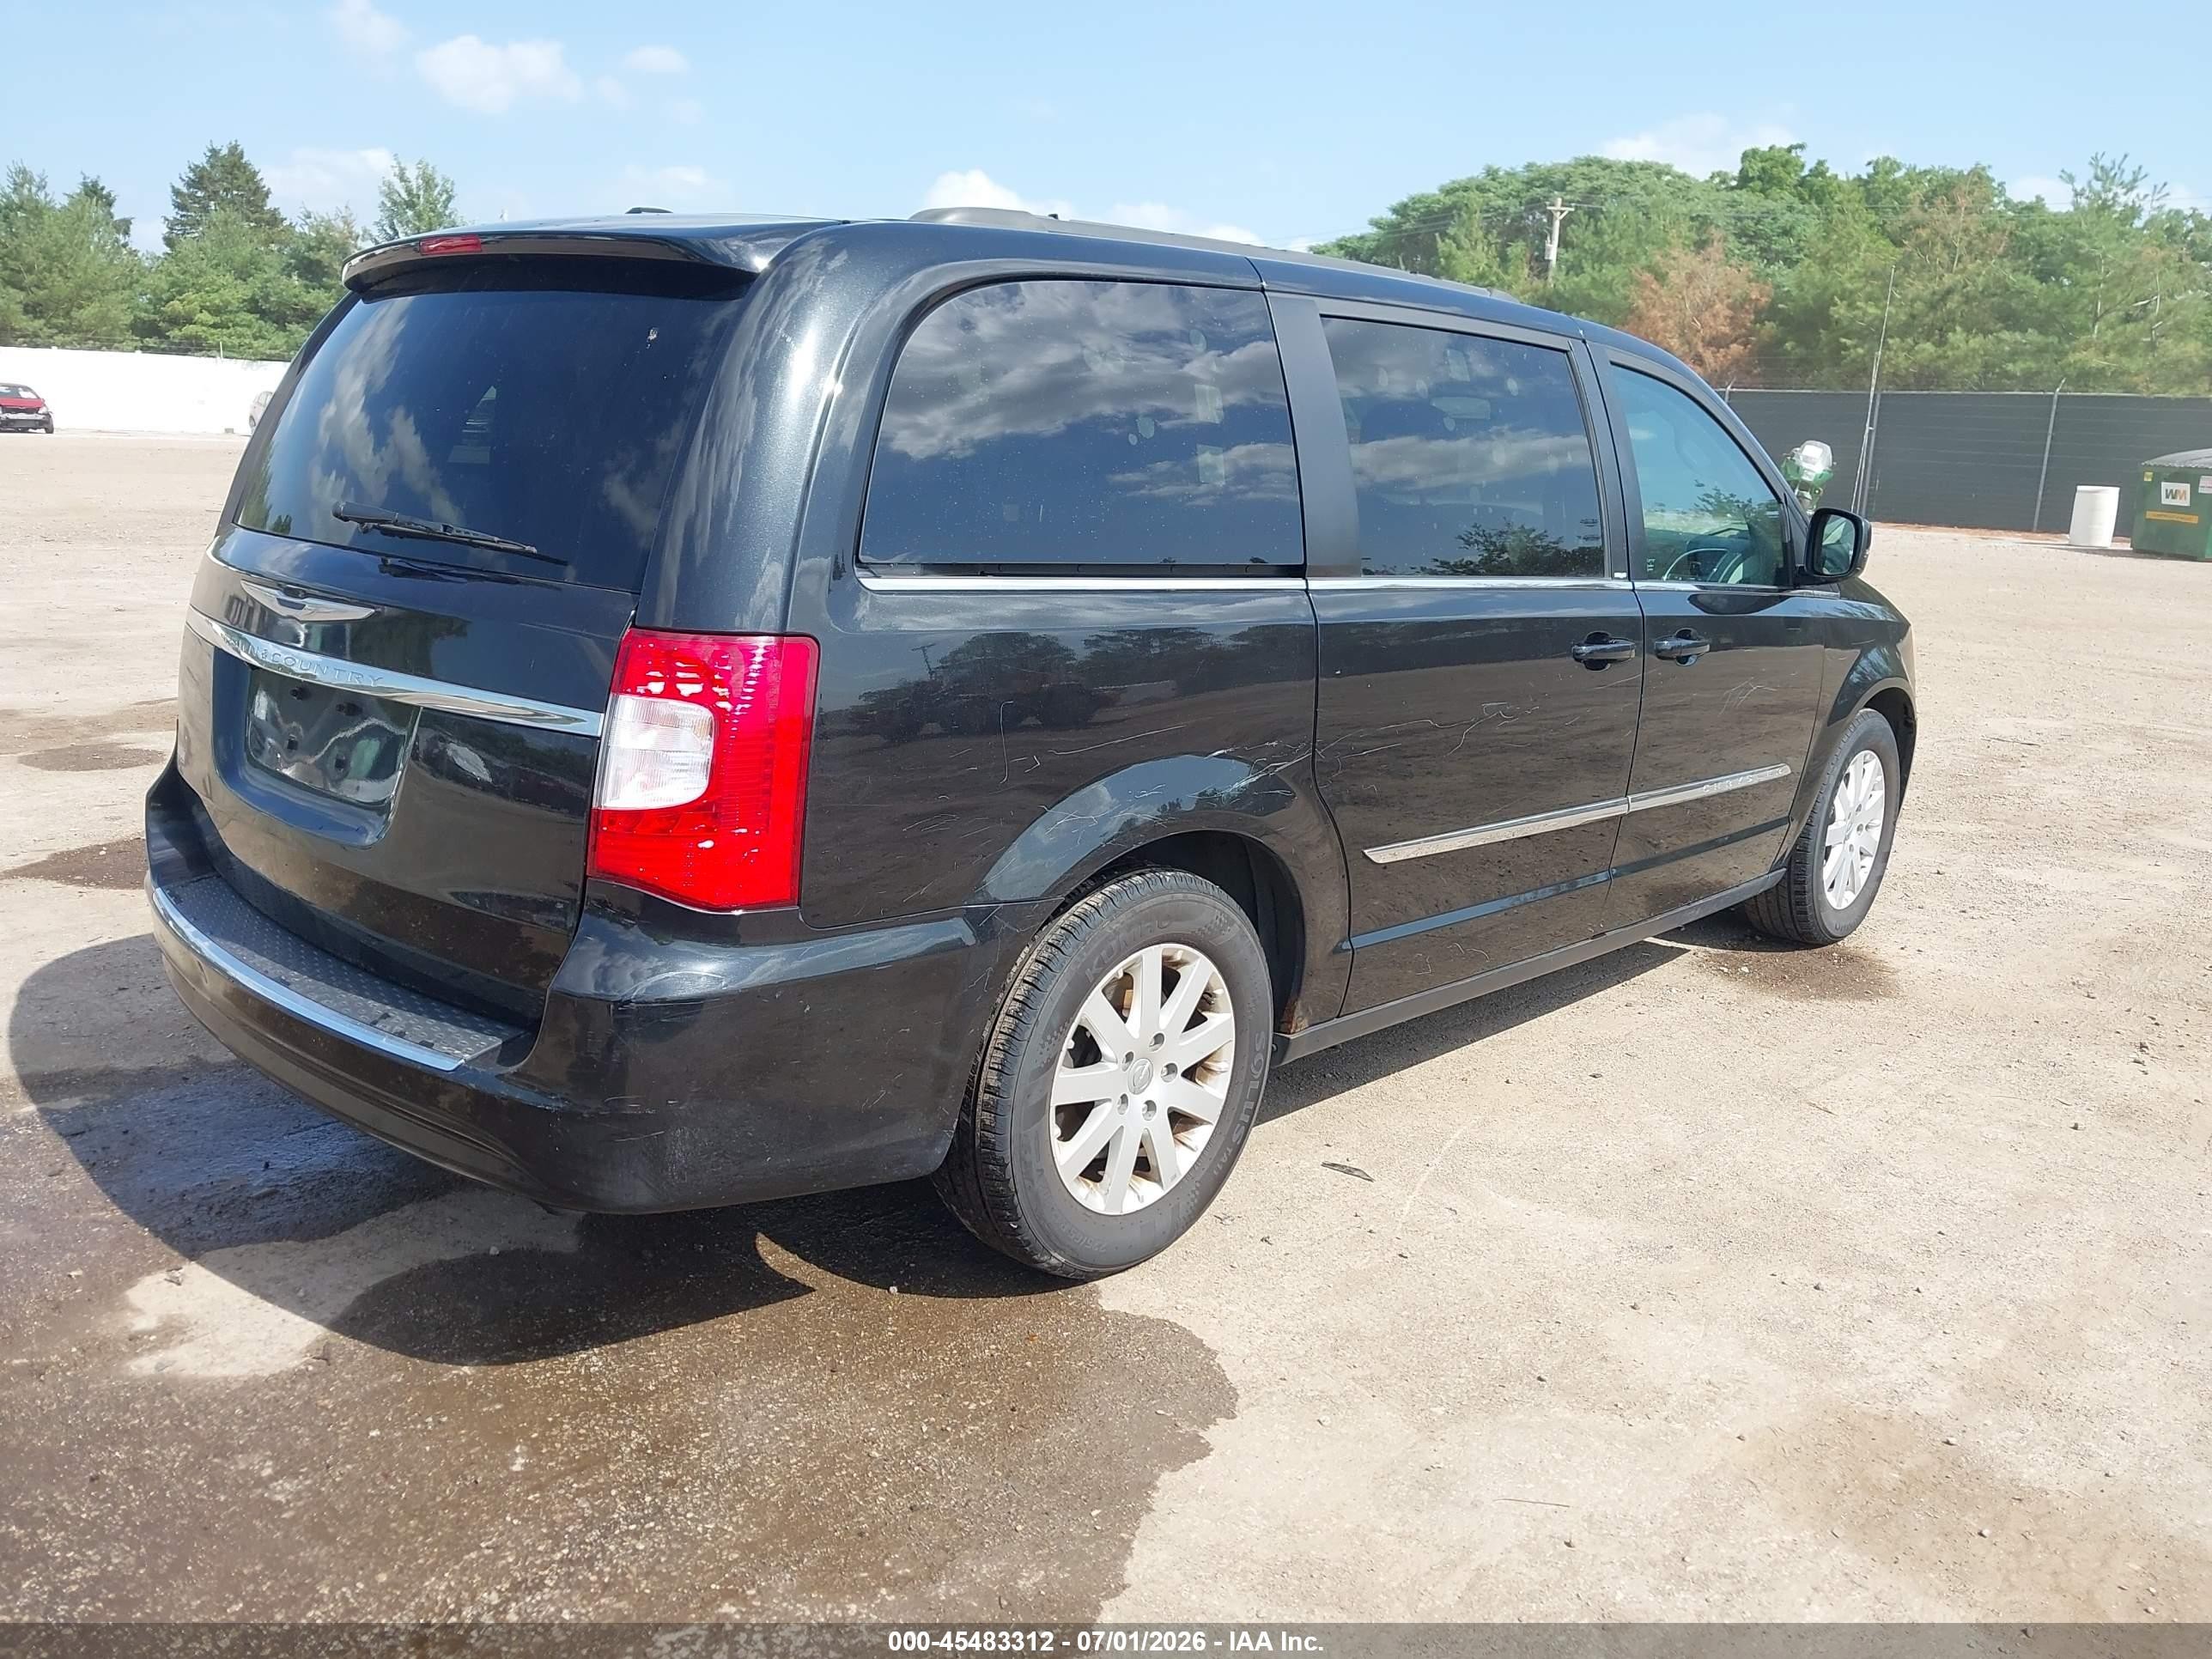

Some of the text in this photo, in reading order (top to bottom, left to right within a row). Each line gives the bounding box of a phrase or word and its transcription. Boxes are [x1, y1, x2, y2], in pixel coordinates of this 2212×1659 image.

[2165, 488, 2186, 501] WM
[1703, 768, 1784, 792] CHRYSER
[1231, 1030, 1266, 1146] SOLUS
